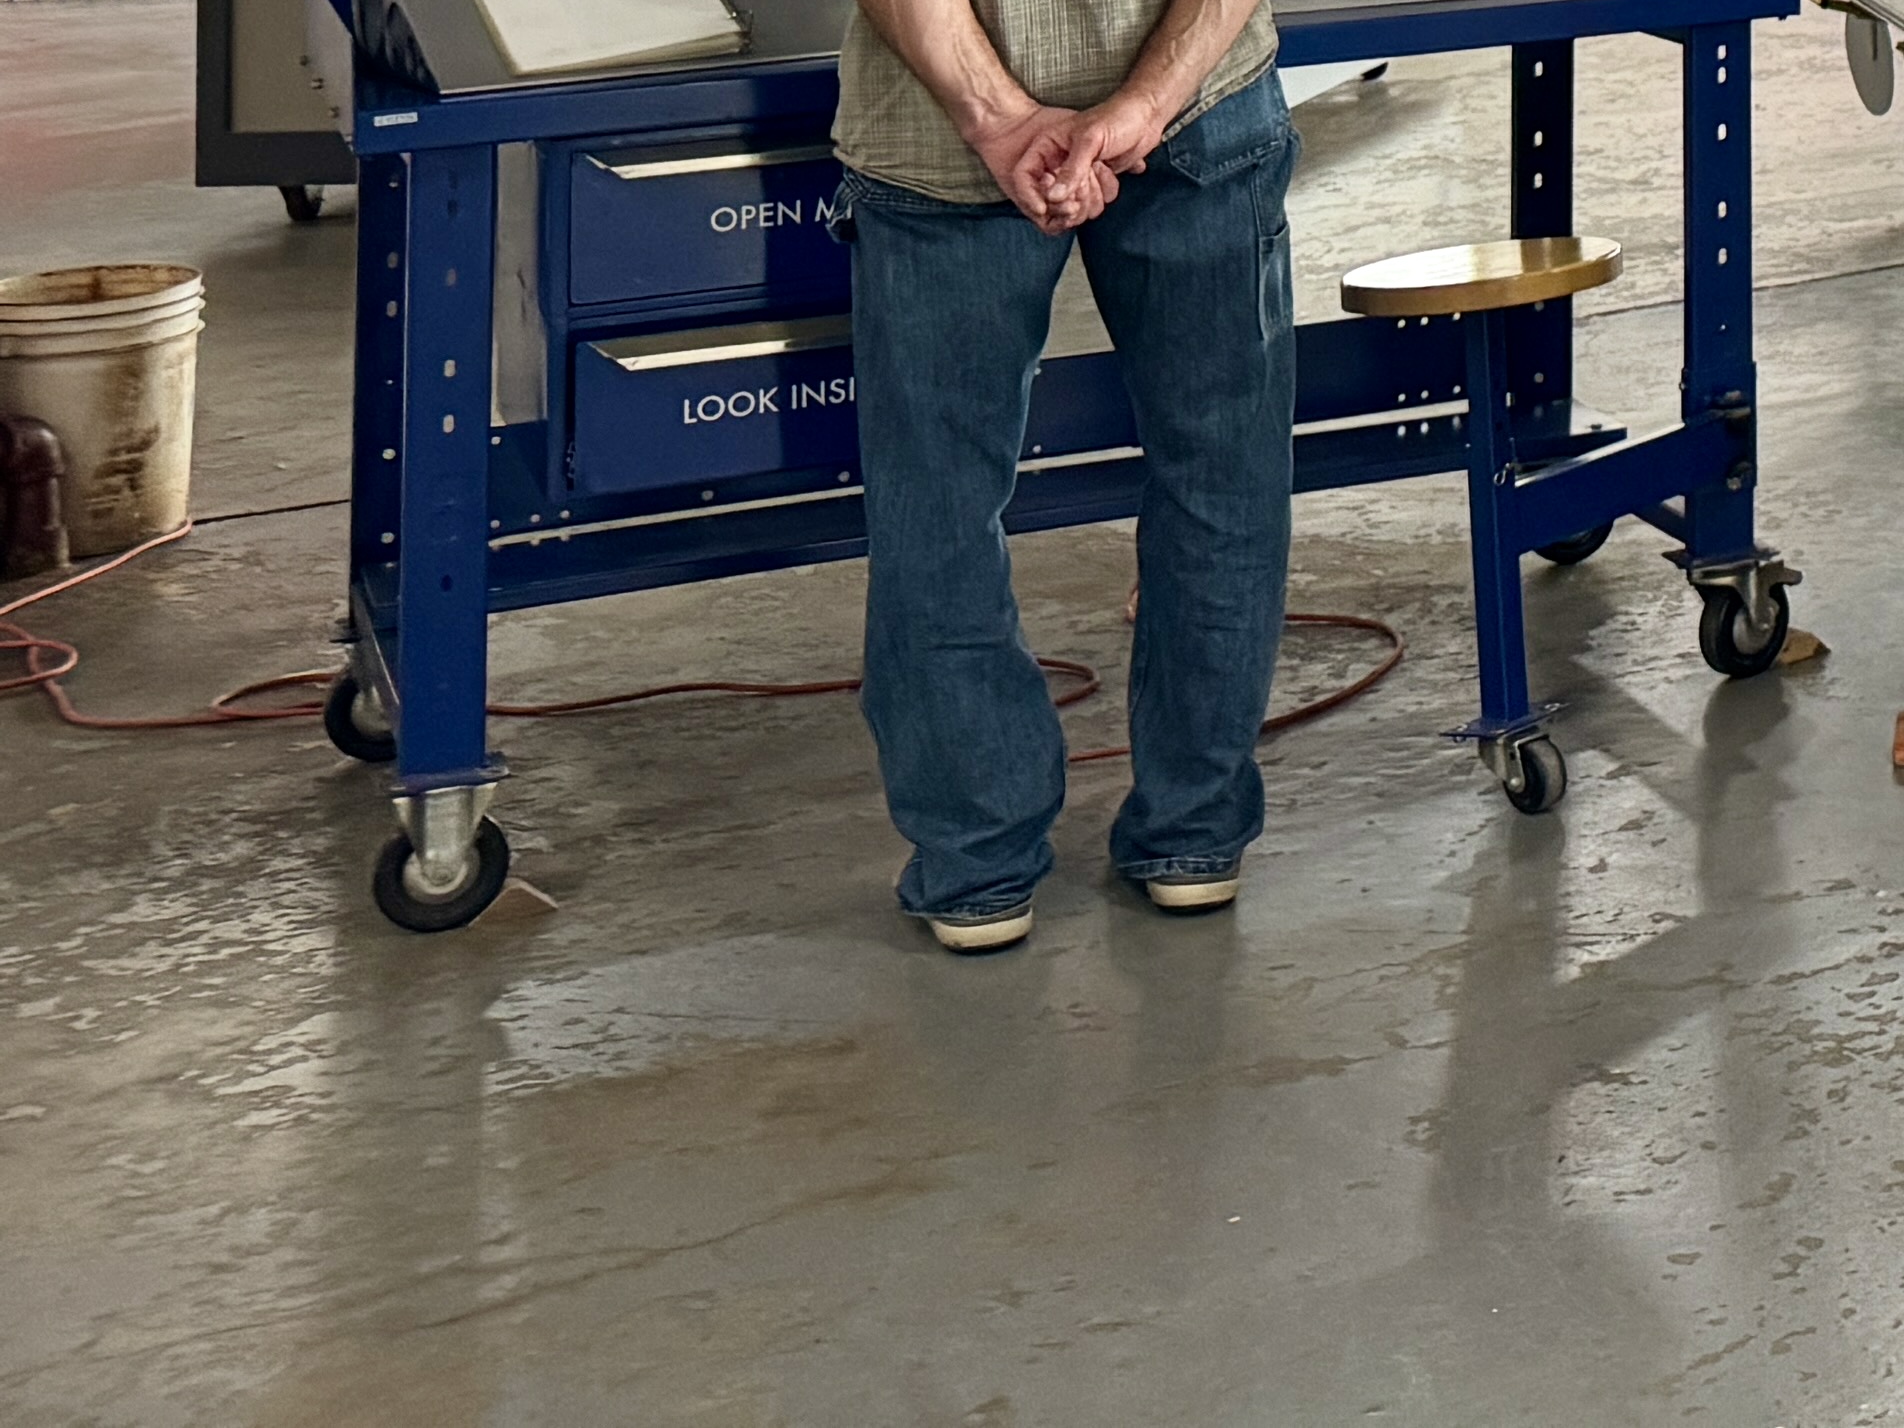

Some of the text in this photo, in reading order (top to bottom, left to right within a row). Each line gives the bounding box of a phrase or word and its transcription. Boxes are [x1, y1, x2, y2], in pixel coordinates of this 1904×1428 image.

[710, 199, 801, 232] OPEN
[683, 376, 855, 425] LOOK INSI
